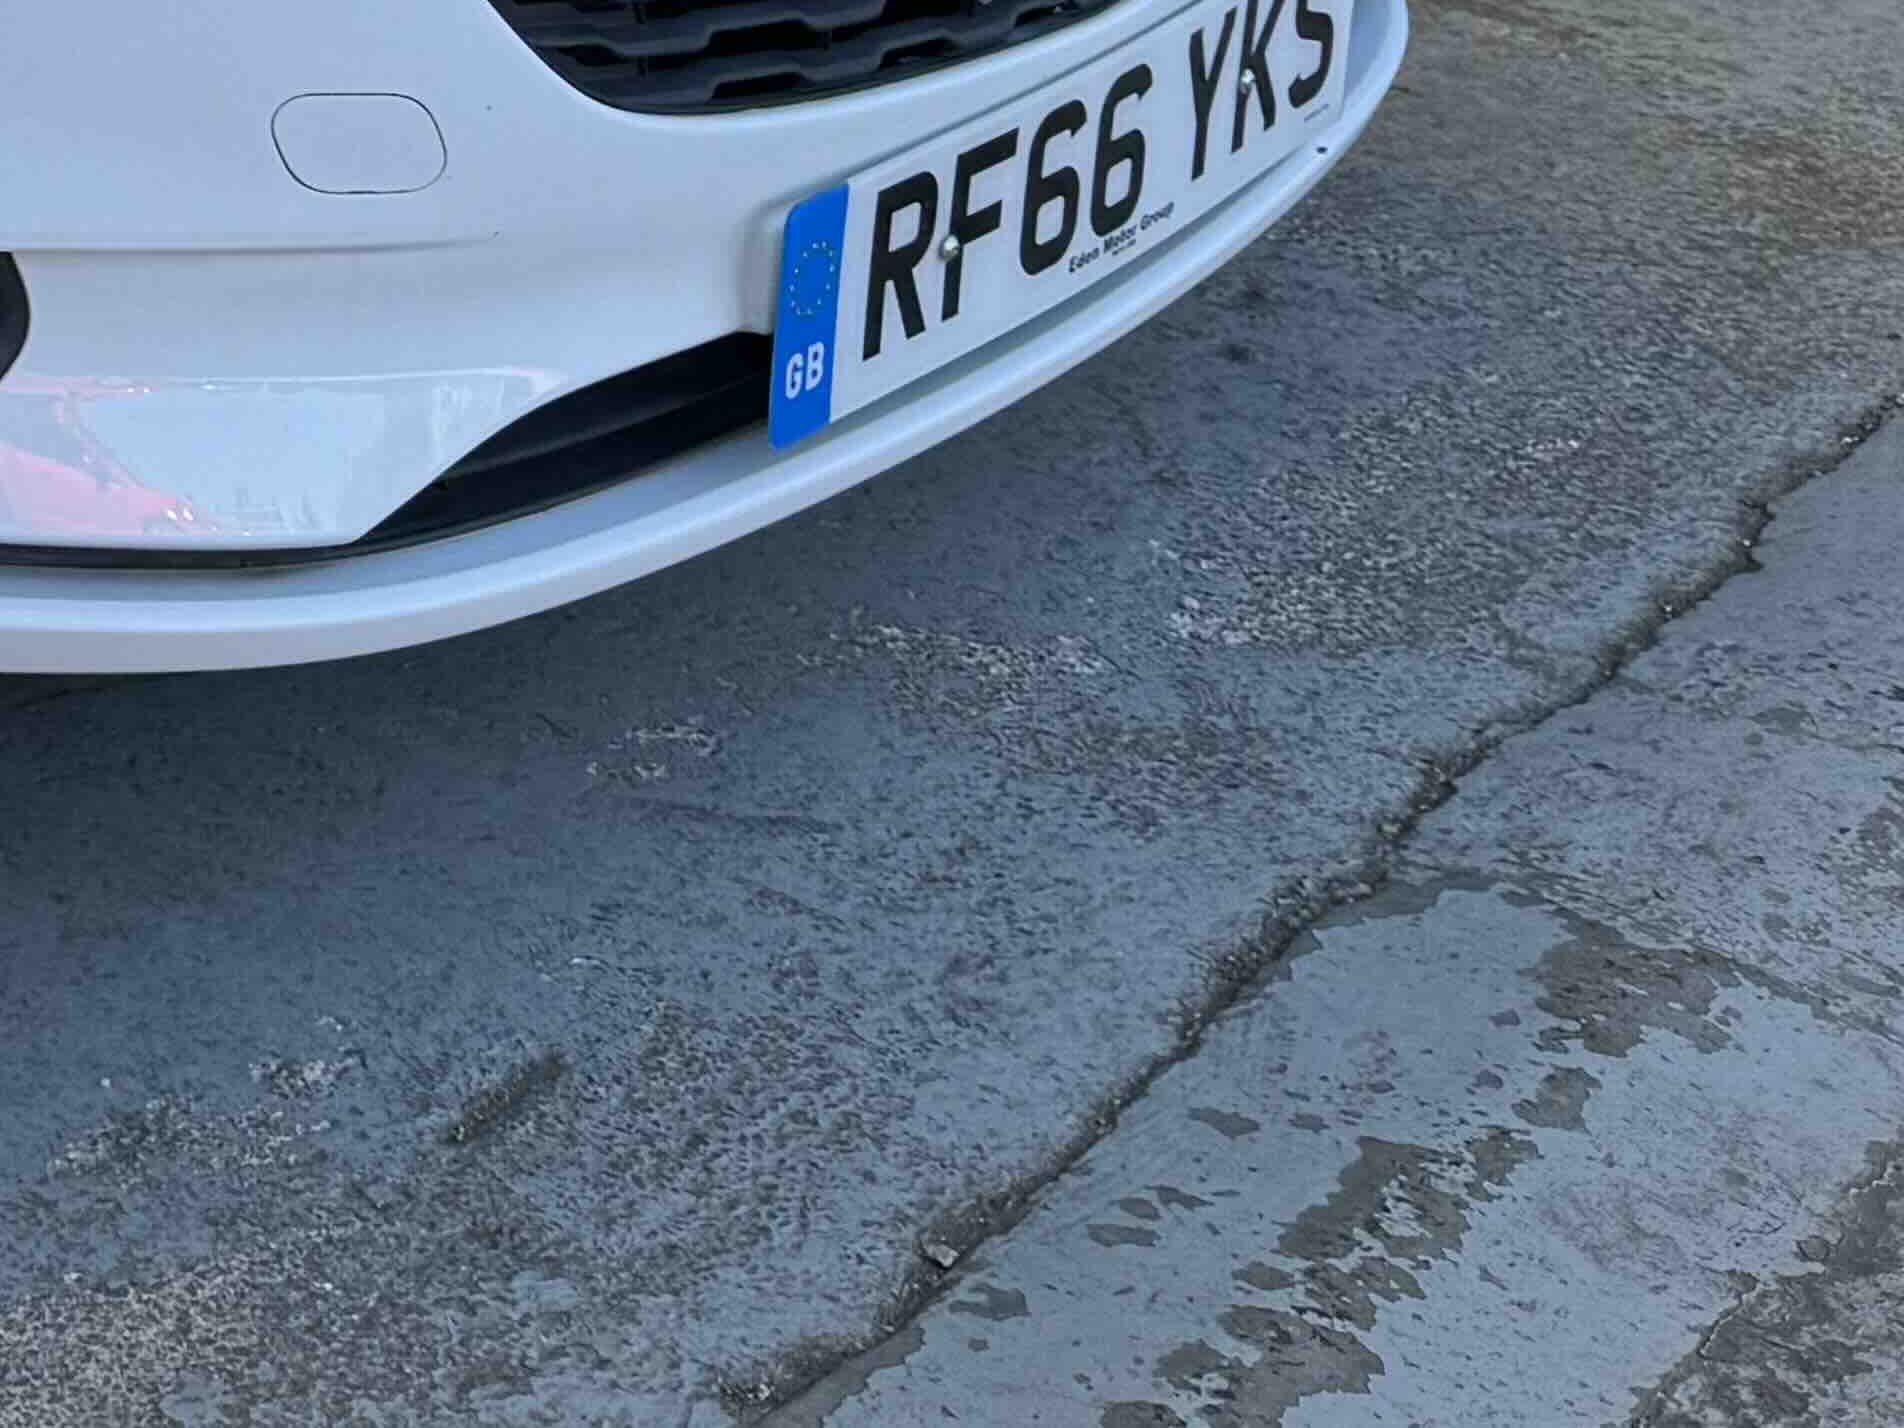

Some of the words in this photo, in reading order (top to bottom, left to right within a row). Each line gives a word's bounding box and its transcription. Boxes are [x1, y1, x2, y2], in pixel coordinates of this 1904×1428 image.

[862, 63, 1153, 361] RF66
[1069, 247, 1100, 274] Eden
[1103, 224, 1137, 254] Motor
[1140, 202, 1174, 231] Group
[784, 341, 825, 399] GB
